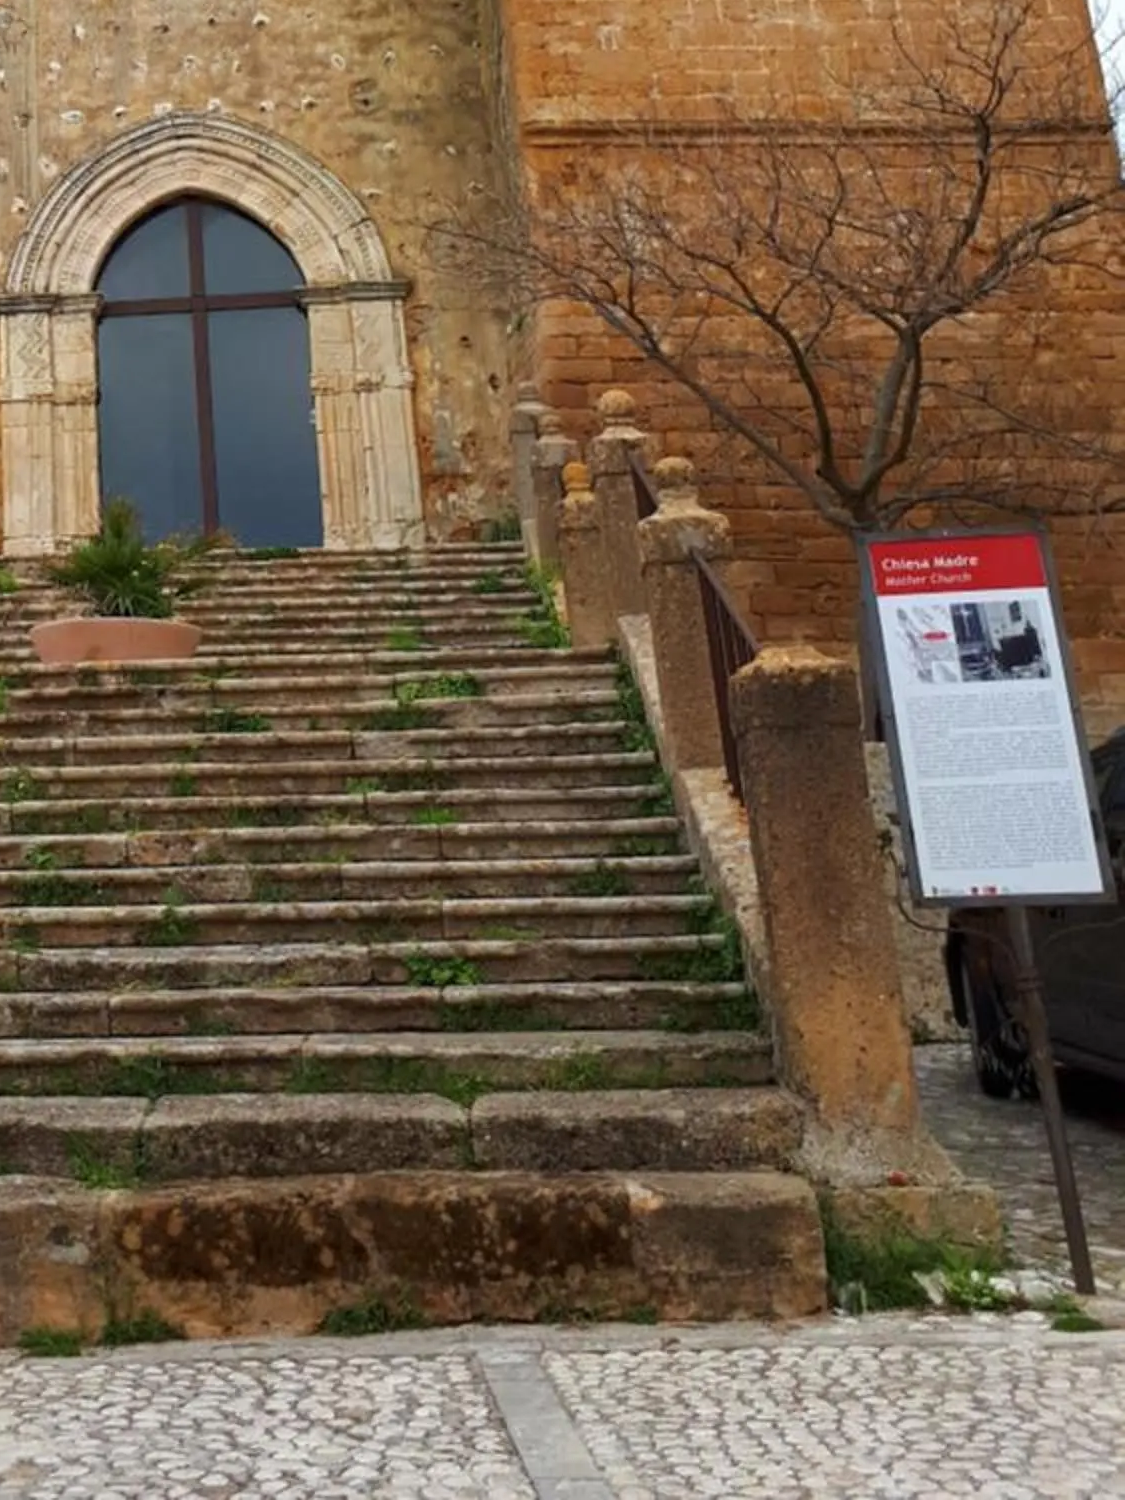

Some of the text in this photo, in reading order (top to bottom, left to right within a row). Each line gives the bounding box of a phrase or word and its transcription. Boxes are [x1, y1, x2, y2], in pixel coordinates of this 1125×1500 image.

[881, 555, 979, 571] Chiesa Madre
[885, 572, 972, 586] Mother Church
